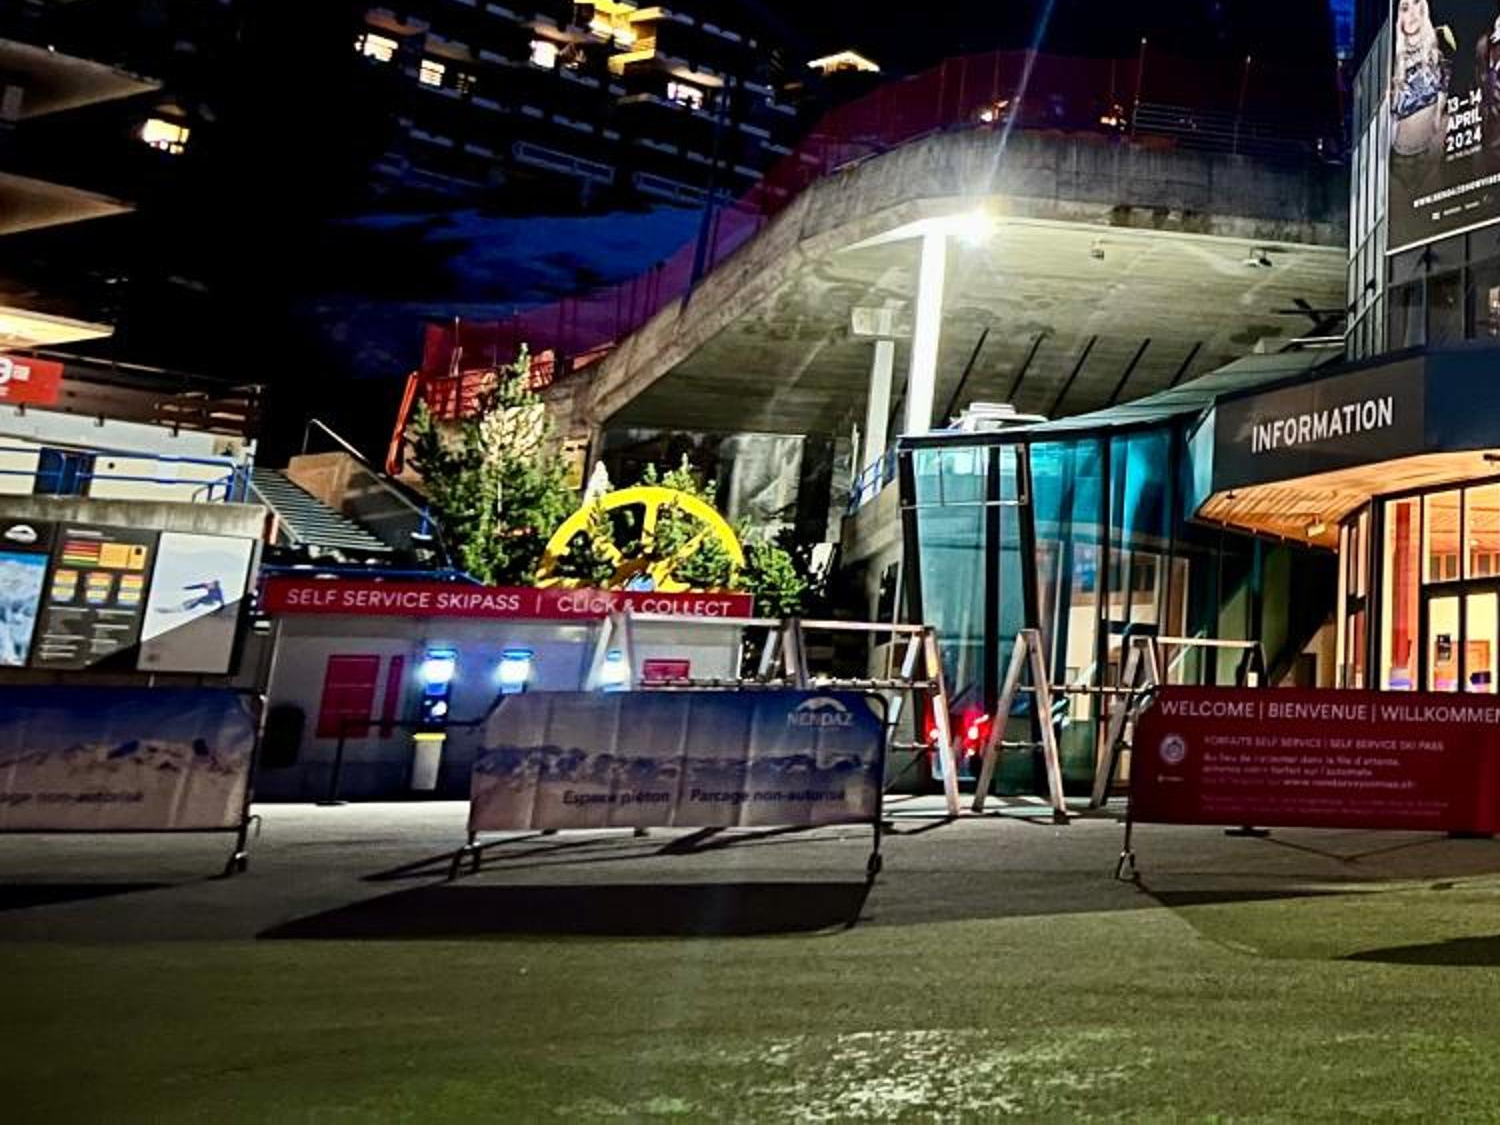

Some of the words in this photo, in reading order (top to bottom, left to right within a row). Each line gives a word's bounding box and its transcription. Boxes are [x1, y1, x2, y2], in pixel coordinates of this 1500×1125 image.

[1447, 106, 1483, 132] APRIL
[1446, 125, 1482, 152] 2024
[1251, 396, 1394, 454] INFORMATION
[286, 588, 337, 606] SELF
[343, 590, 430, 609] SERVICE
[436, 592, 520, 612] SKIPASS
[557, 597, 616, 614] CLICK
[640, 599, 732, 618] COLLECT
[1160, 700, 1255, 719] WELCOME
[1268, 703, 1367, 721] BIENVENUE
